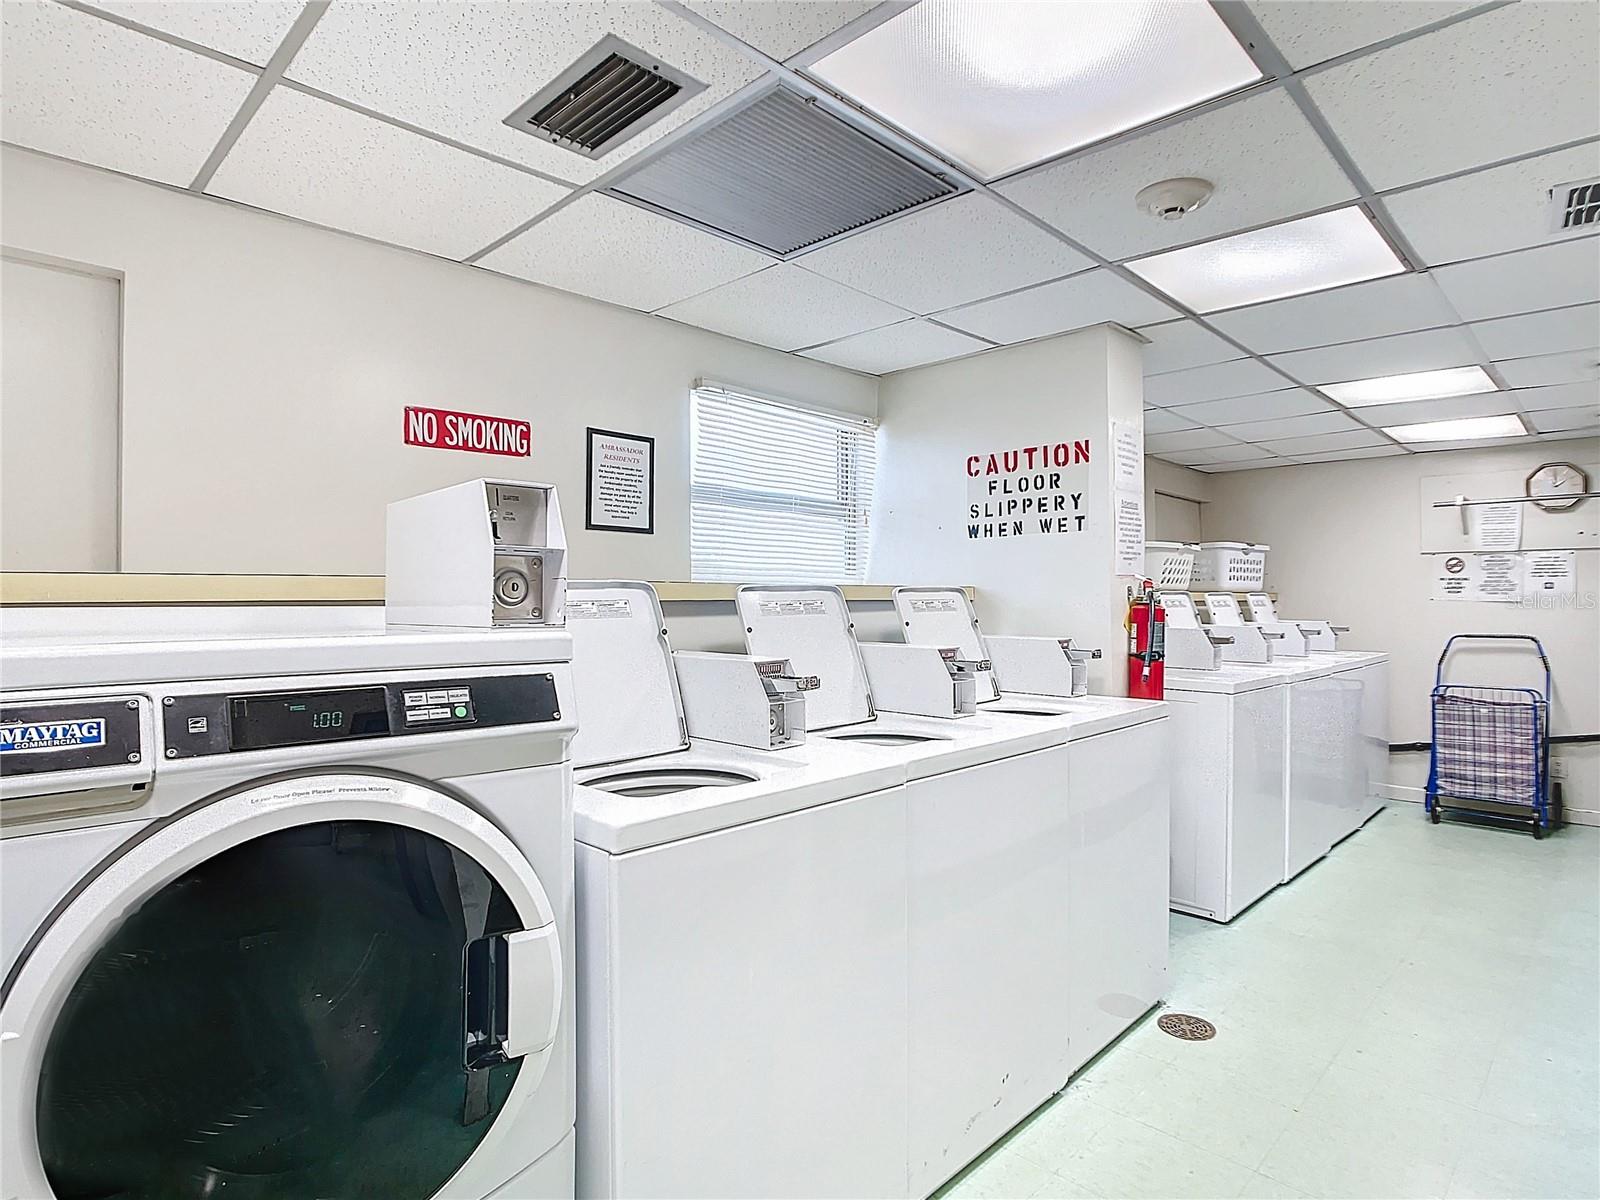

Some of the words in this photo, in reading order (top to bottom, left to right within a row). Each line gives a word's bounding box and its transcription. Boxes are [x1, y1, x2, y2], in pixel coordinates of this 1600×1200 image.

[408, 410, 438, 444] NO
[444, 415, 528, 454] SMOKING
[600, 443, 643, 455] AMBASSADOR
[604, 453, 640, 464] RESIDENTS
[966, 439, 1090, 478] CAUTION
[988, 472, 1061, 496] FLOOR
[969, 492, 1082, 519] SLIPPERY
[967, 520, 1023, 539] WHEN
[1039, 515, 1086, 534] WET
[0, 721, 99, 745] MAYTAG
[14, 738, 82, 750] COMMERCIAL
